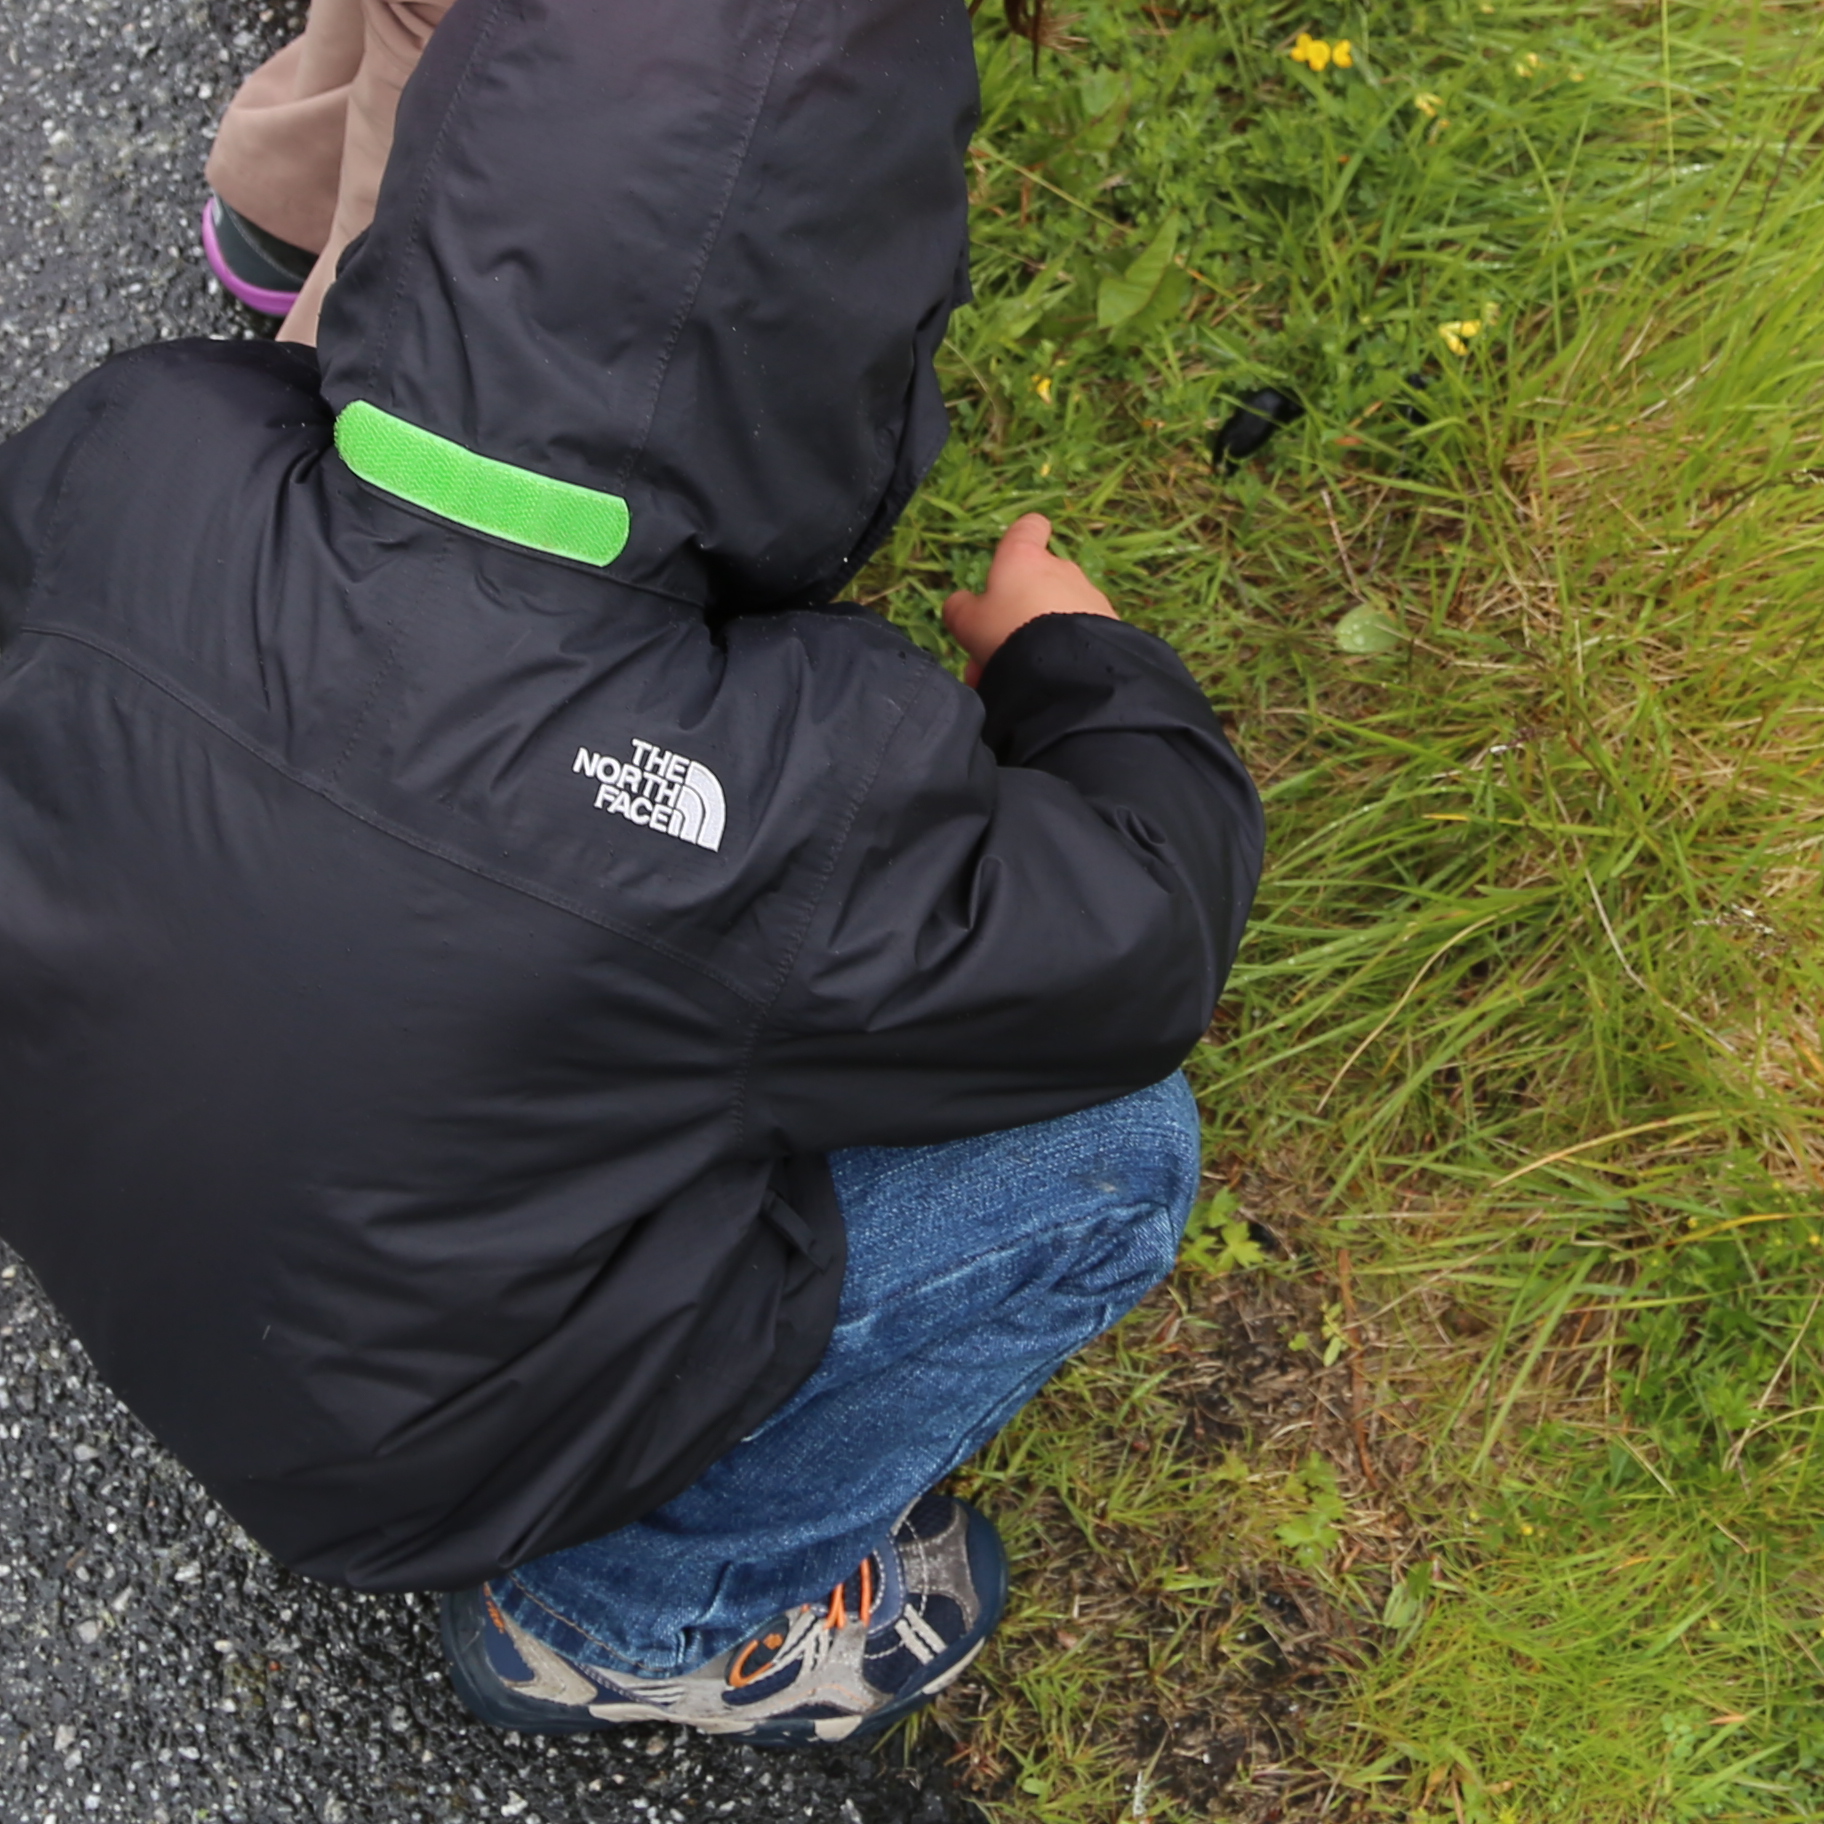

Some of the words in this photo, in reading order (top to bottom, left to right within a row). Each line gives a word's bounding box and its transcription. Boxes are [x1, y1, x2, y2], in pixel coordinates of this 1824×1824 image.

[573, 747, 681, 807] NORTH
[632, 739, 690, 782] THE
[594, 784, 672, 832] FACE
